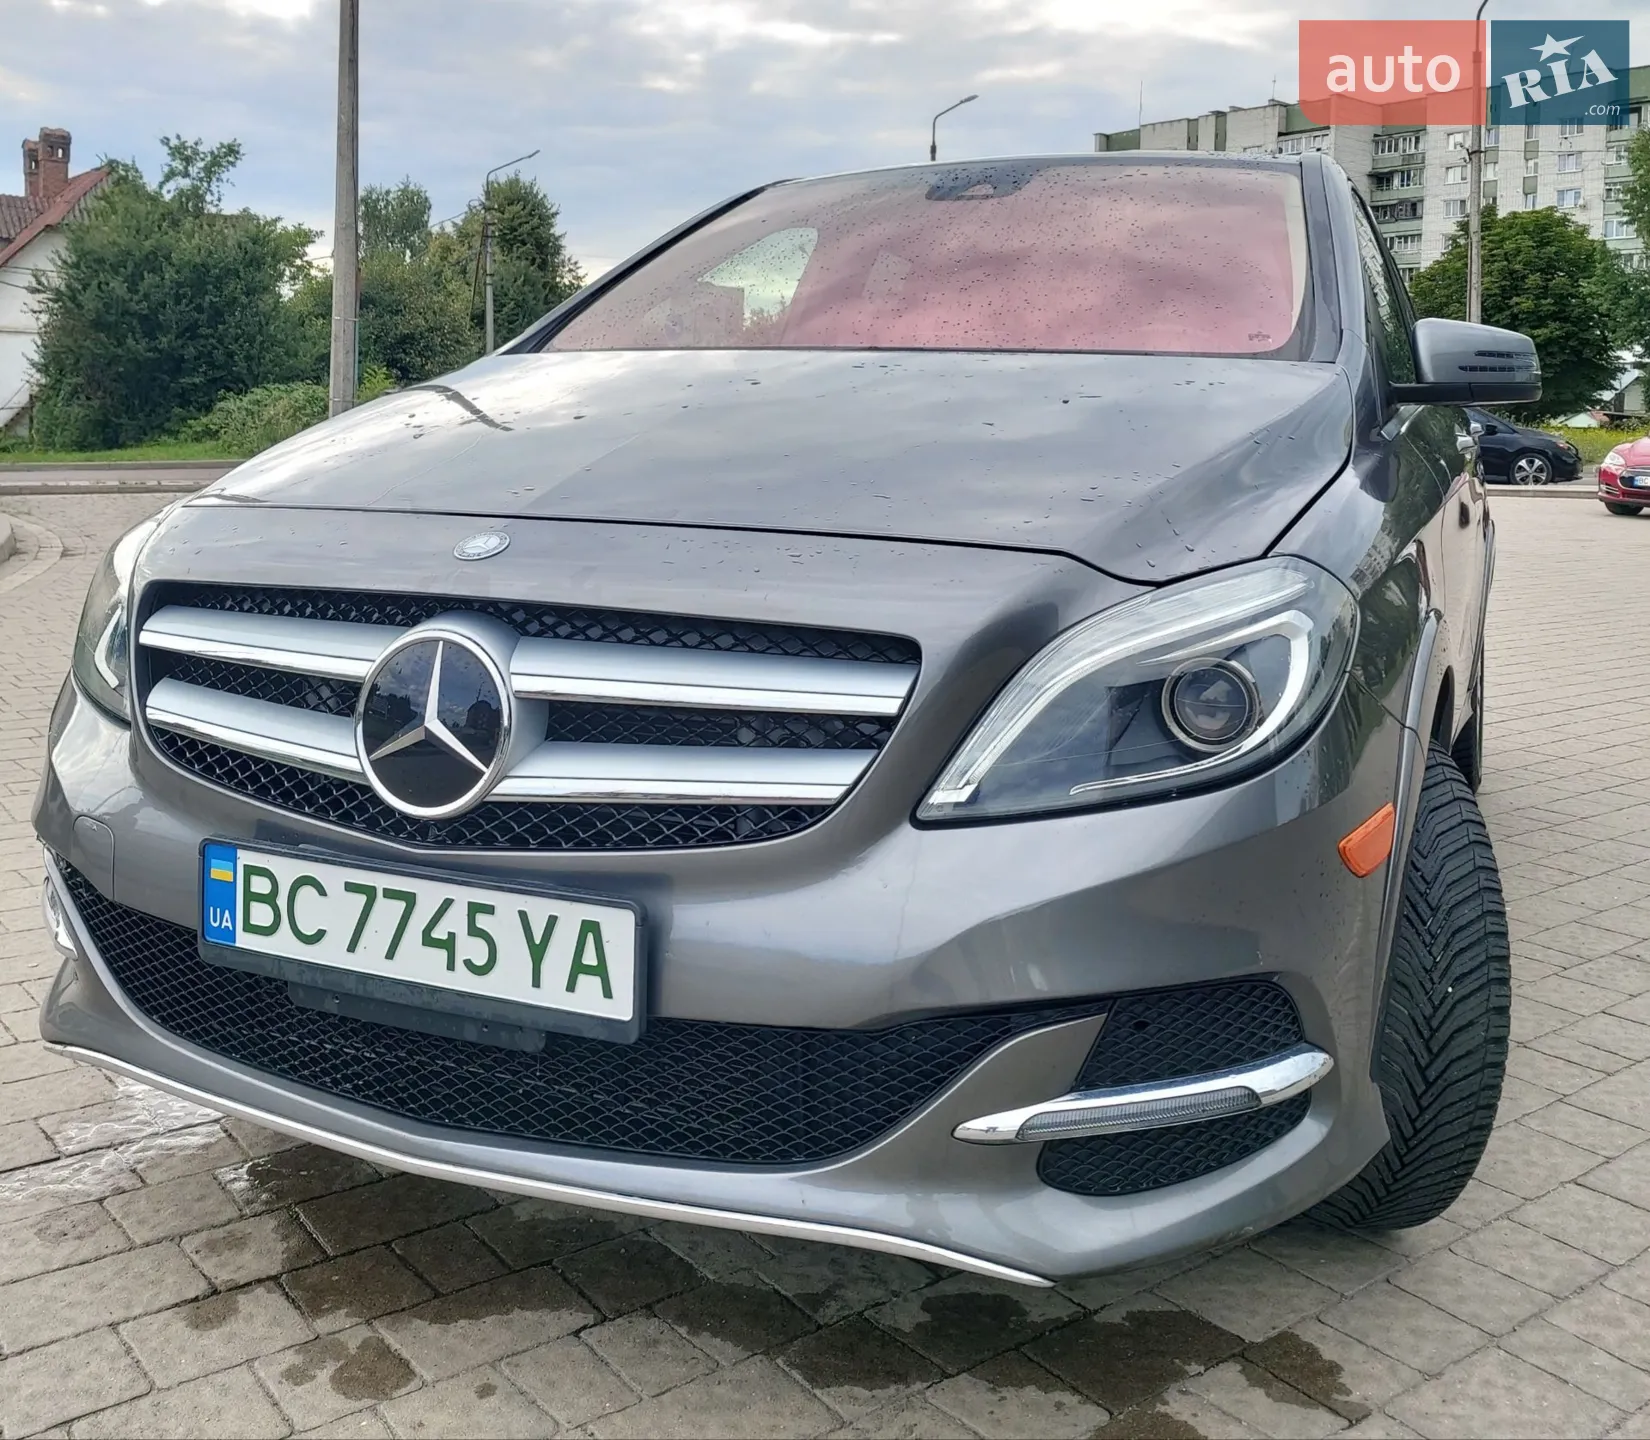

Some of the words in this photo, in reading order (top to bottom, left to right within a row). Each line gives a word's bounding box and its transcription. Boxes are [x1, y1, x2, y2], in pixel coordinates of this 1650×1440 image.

[209, 907, 233, 931] UA
[242, 863, 328, 945] BC
[343, 881, 498, 976] 7745
[517, 908, 614, 999] YA
